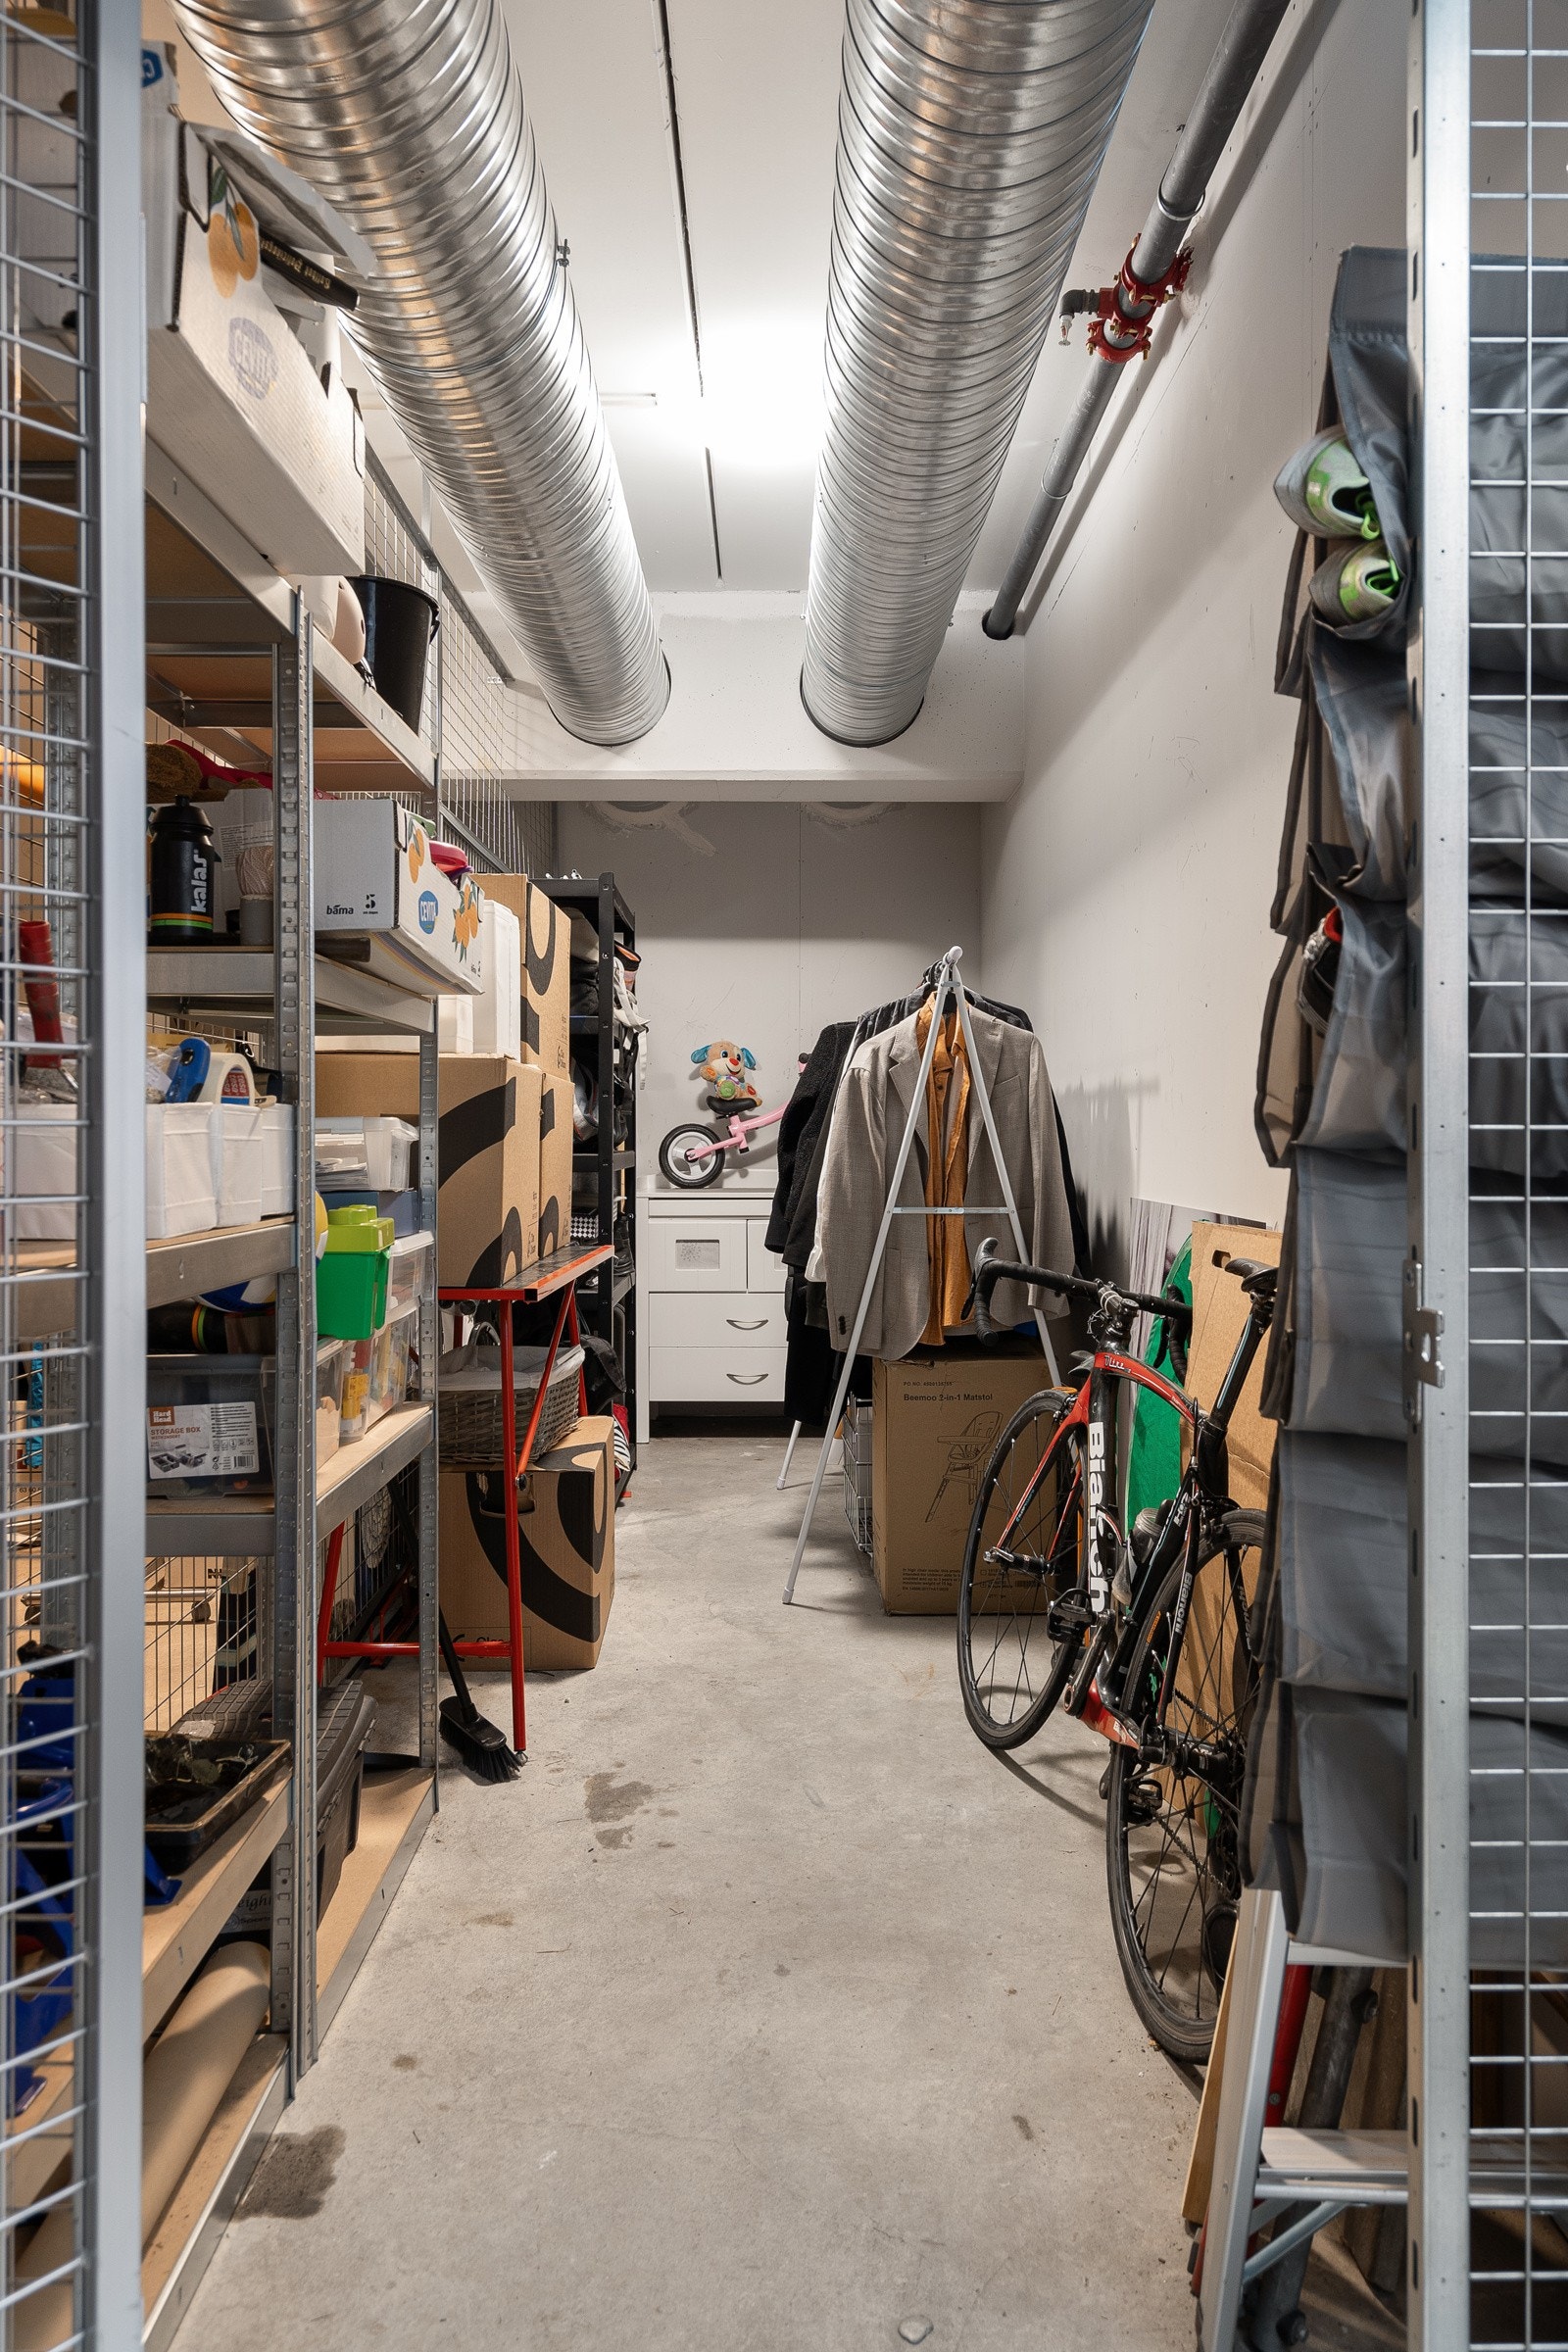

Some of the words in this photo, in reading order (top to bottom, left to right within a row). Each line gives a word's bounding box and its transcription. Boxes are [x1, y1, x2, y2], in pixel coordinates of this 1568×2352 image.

[191, 854, 207, 913] kalas
[963, 1393, 993, 1401] Matstol
[150, 1427, 184, 1436] STORAGE
[1089, 1421, 1108, 1614] Biach
[1175, 1571, 1193, 1635] Bianchi
